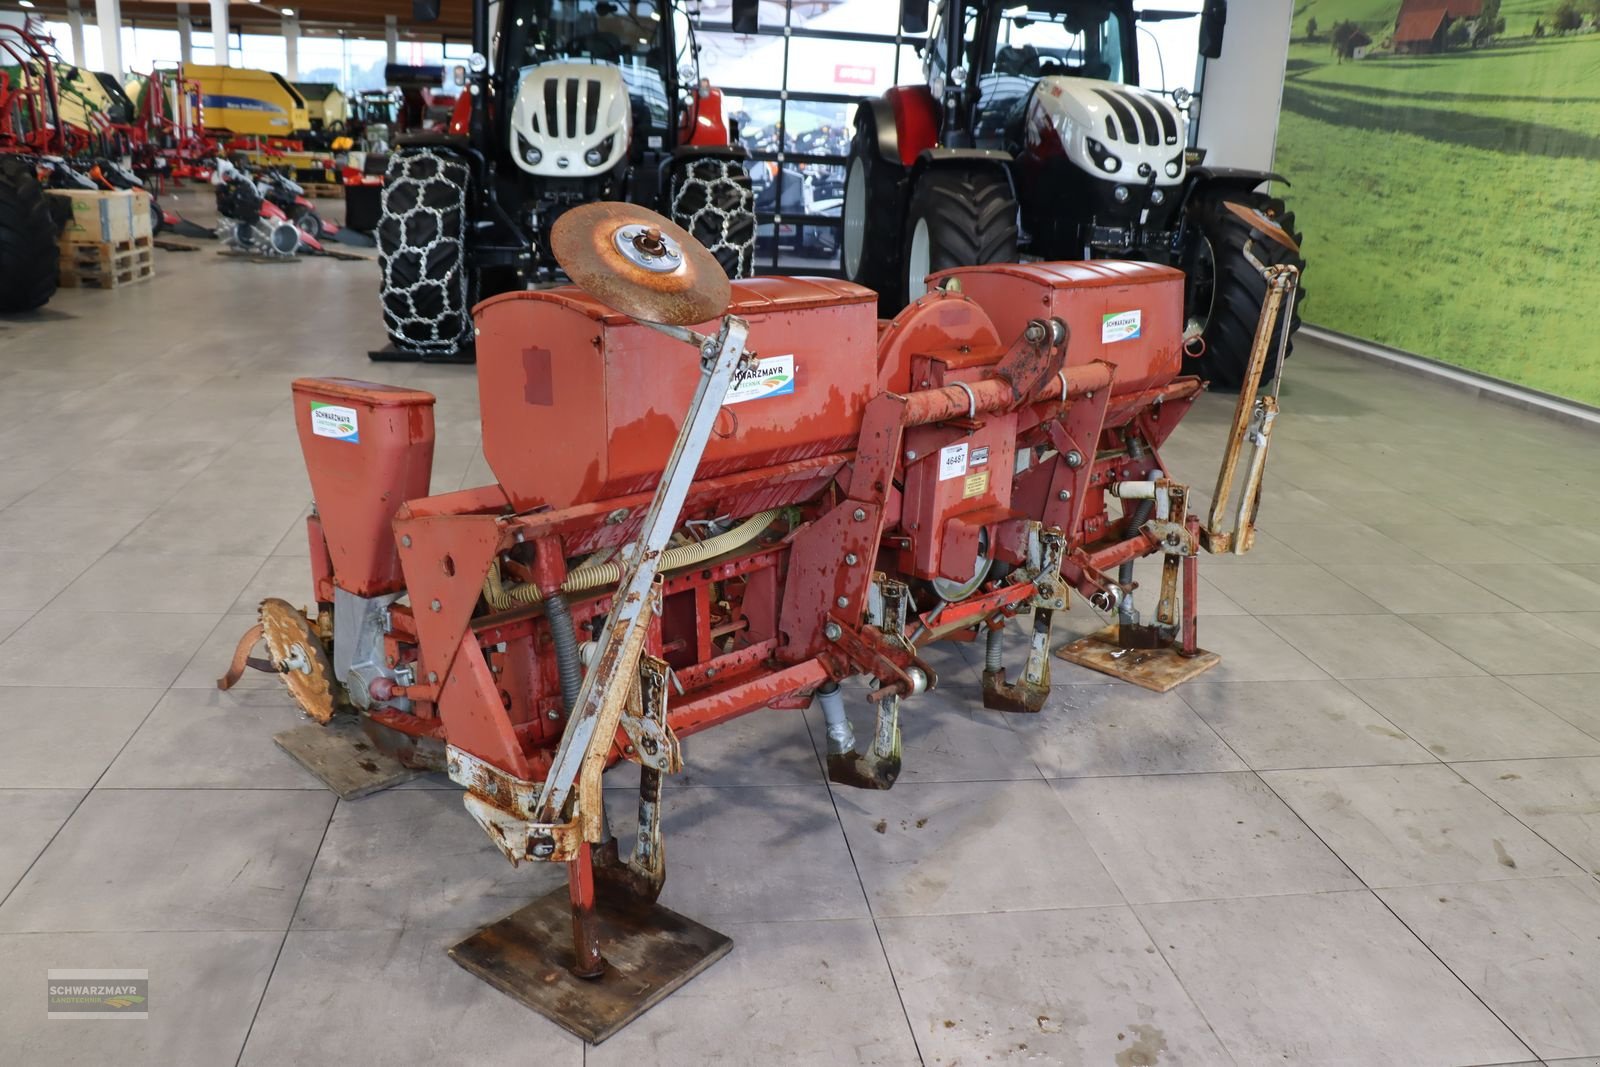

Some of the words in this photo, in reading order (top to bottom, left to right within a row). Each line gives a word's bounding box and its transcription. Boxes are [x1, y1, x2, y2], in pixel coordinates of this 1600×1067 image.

[1106, 318, 1136, 328] SCHWARZMAYR
[734, 366, 783, 382] HWARZMAYR
[315, 410, 350, 423] SCHWARZMAYR
[946, 454, 965, 466] 46487
